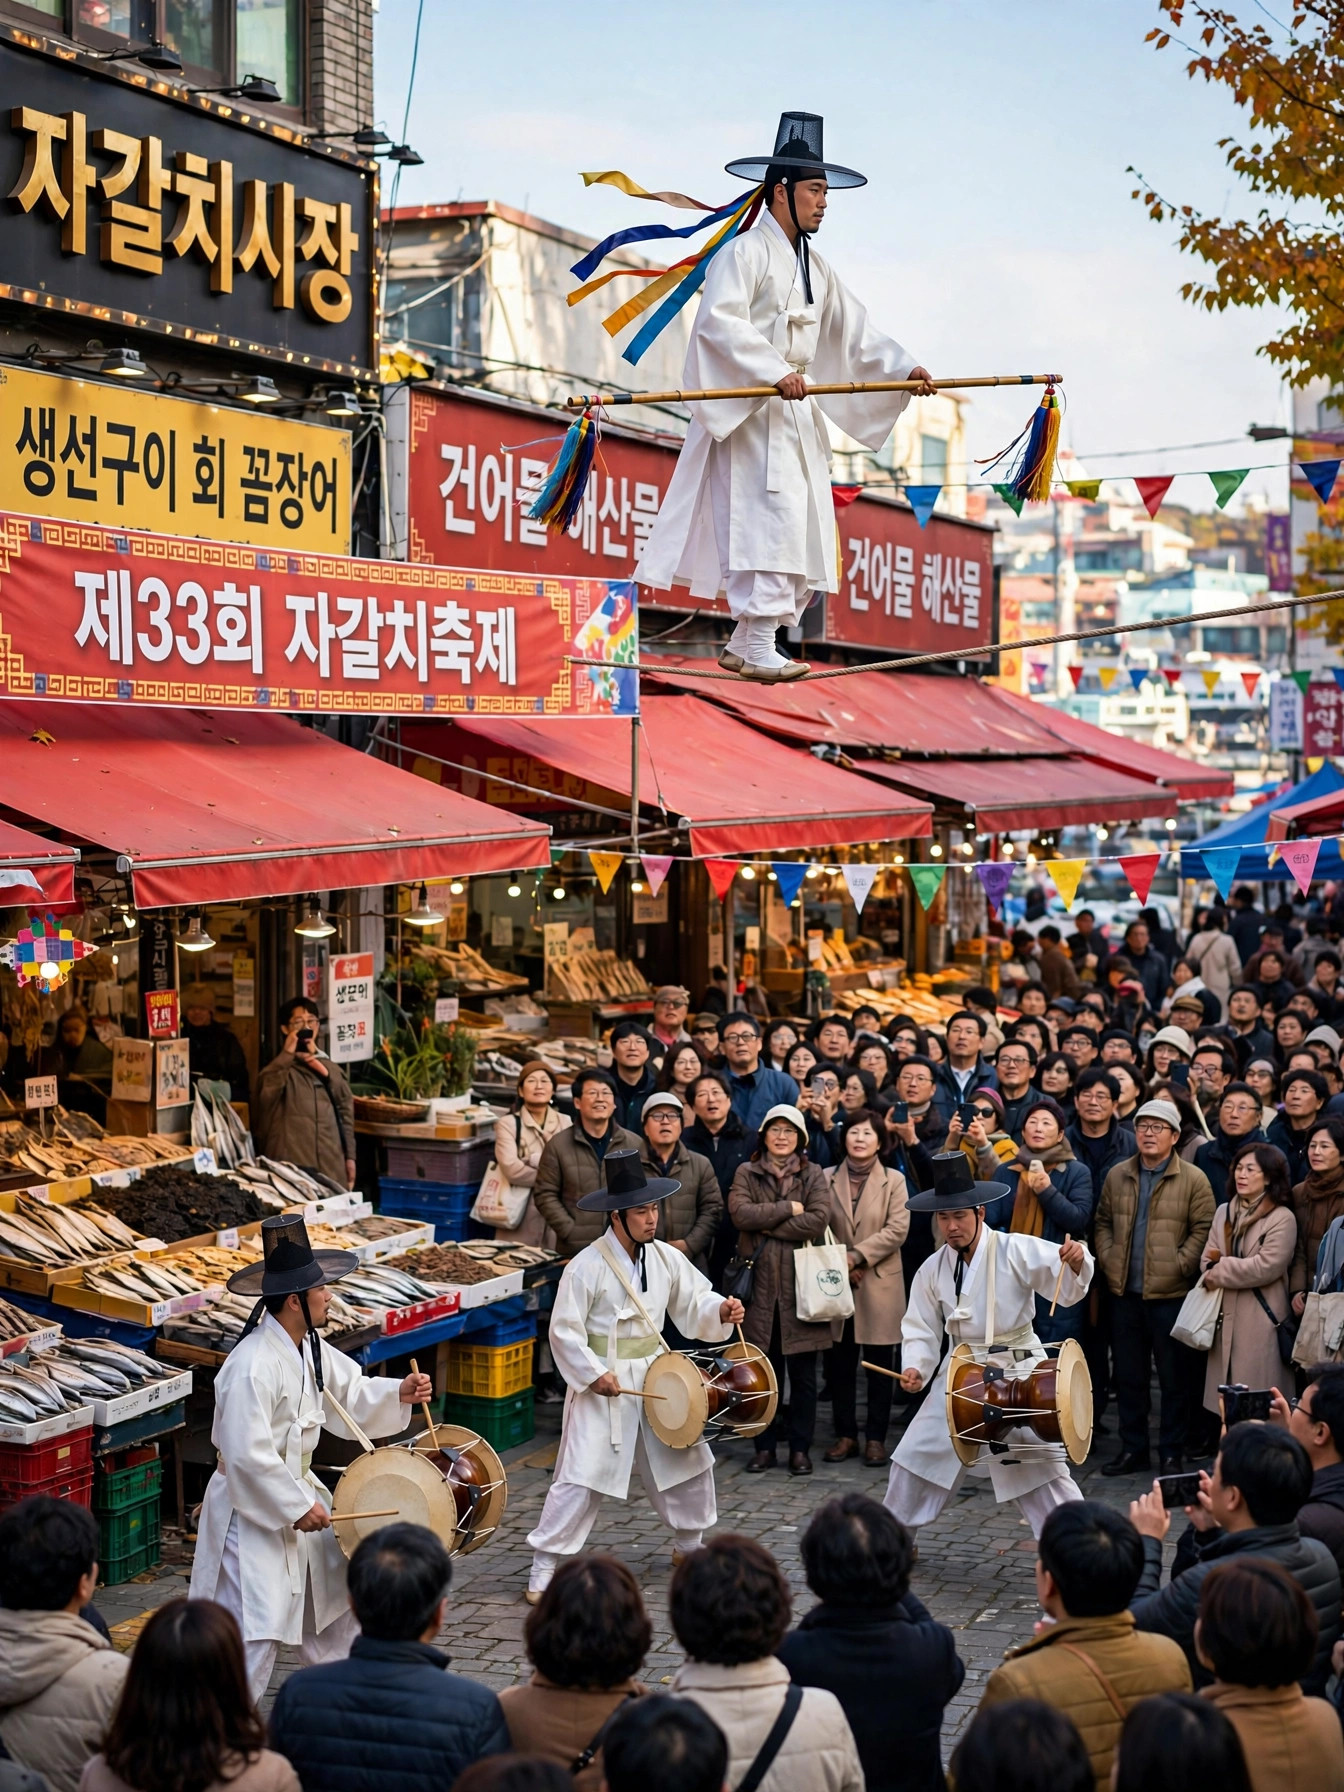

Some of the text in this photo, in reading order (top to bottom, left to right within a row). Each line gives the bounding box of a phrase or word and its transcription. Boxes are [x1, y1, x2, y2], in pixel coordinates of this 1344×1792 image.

[7, 106, 359, 323] 자갈치시장
[15, 406, 338, 534] 생선구이 회 꼼장어
[439, 443, 548, 547] 건어물
[74, 569, 517, 686] 제33회 자갈치축제
[847, 537, 981, 629] 건어물 해산물
